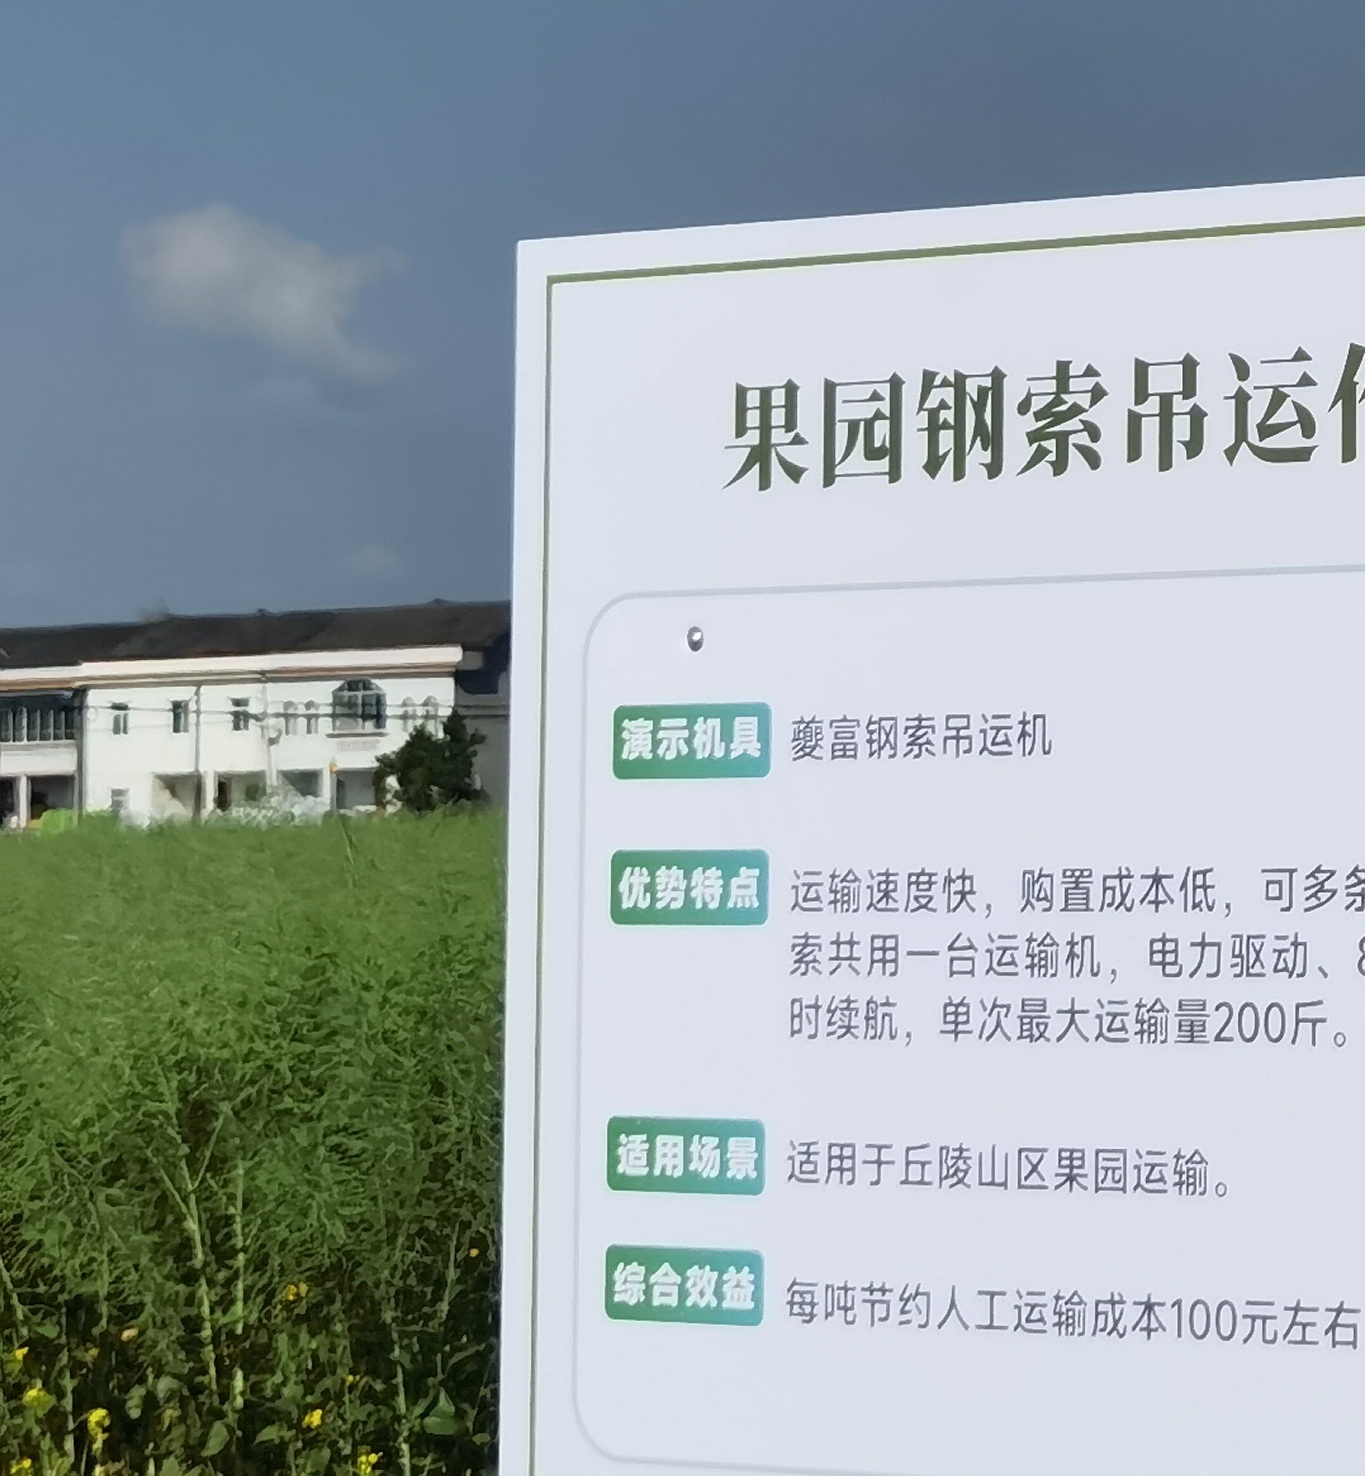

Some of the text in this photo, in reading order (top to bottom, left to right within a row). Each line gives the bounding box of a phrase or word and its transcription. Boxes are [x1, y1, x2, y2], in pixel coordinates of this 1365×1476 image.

[621, 716, 762, 761] 演示机具
[618, 865, 760, 911] 优势特点
[789, 995, 1348, 1049] 时续航，单次最大运输量200斤。
[616, 1133, 759, 1182] 适用场景
[786, 1140, 1229, 1199] 适用于丘陵山区果园运输。
[613, 1260, 756, 1308] 综合效益
